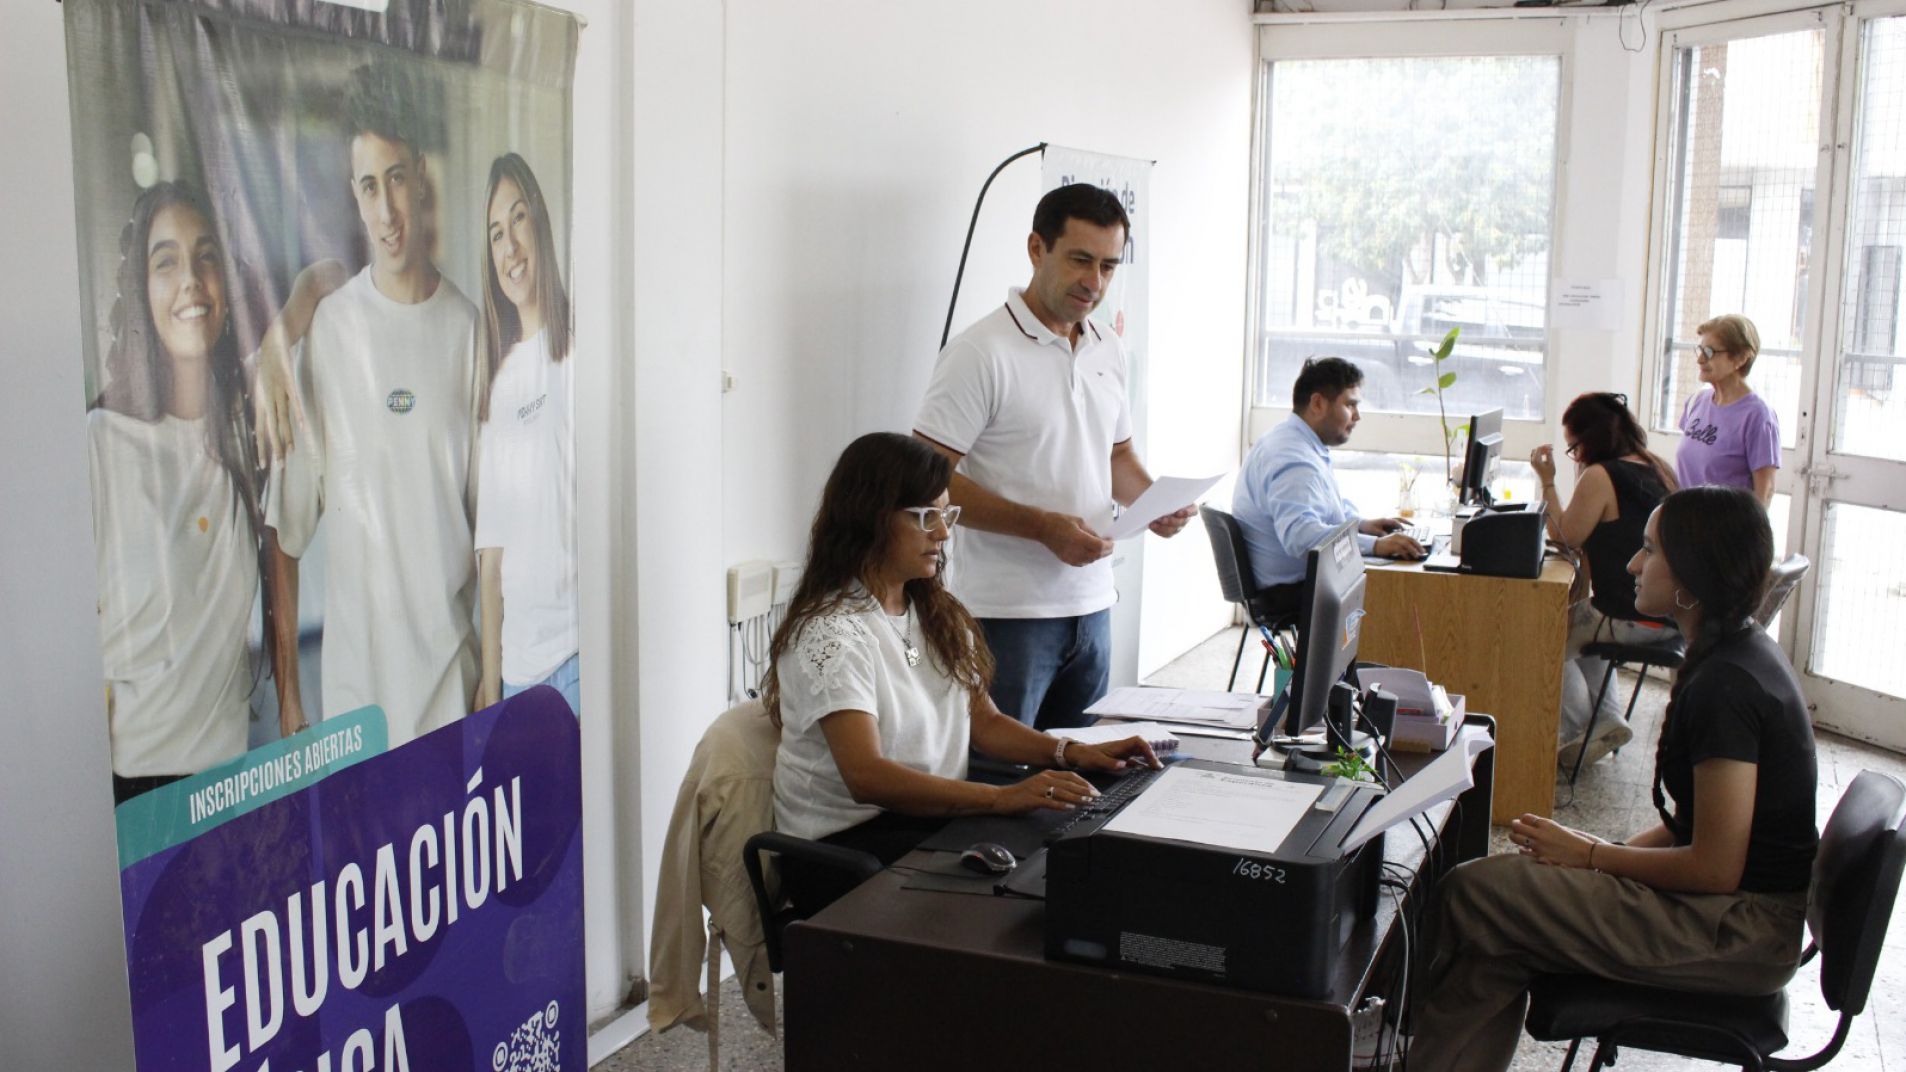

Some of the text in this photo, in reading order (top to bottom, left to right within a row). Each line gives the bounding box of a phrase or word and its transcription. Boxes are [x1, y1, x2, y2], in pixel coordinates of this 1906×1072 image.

[1121, 182, 1135, 214] de
[189, 724, 363, 825] INSCRIPCIONES ABIERTAS
[1232, 857, 1286, 884] 16852
[202, 766, 523, 1072] EDUCACIÓN
